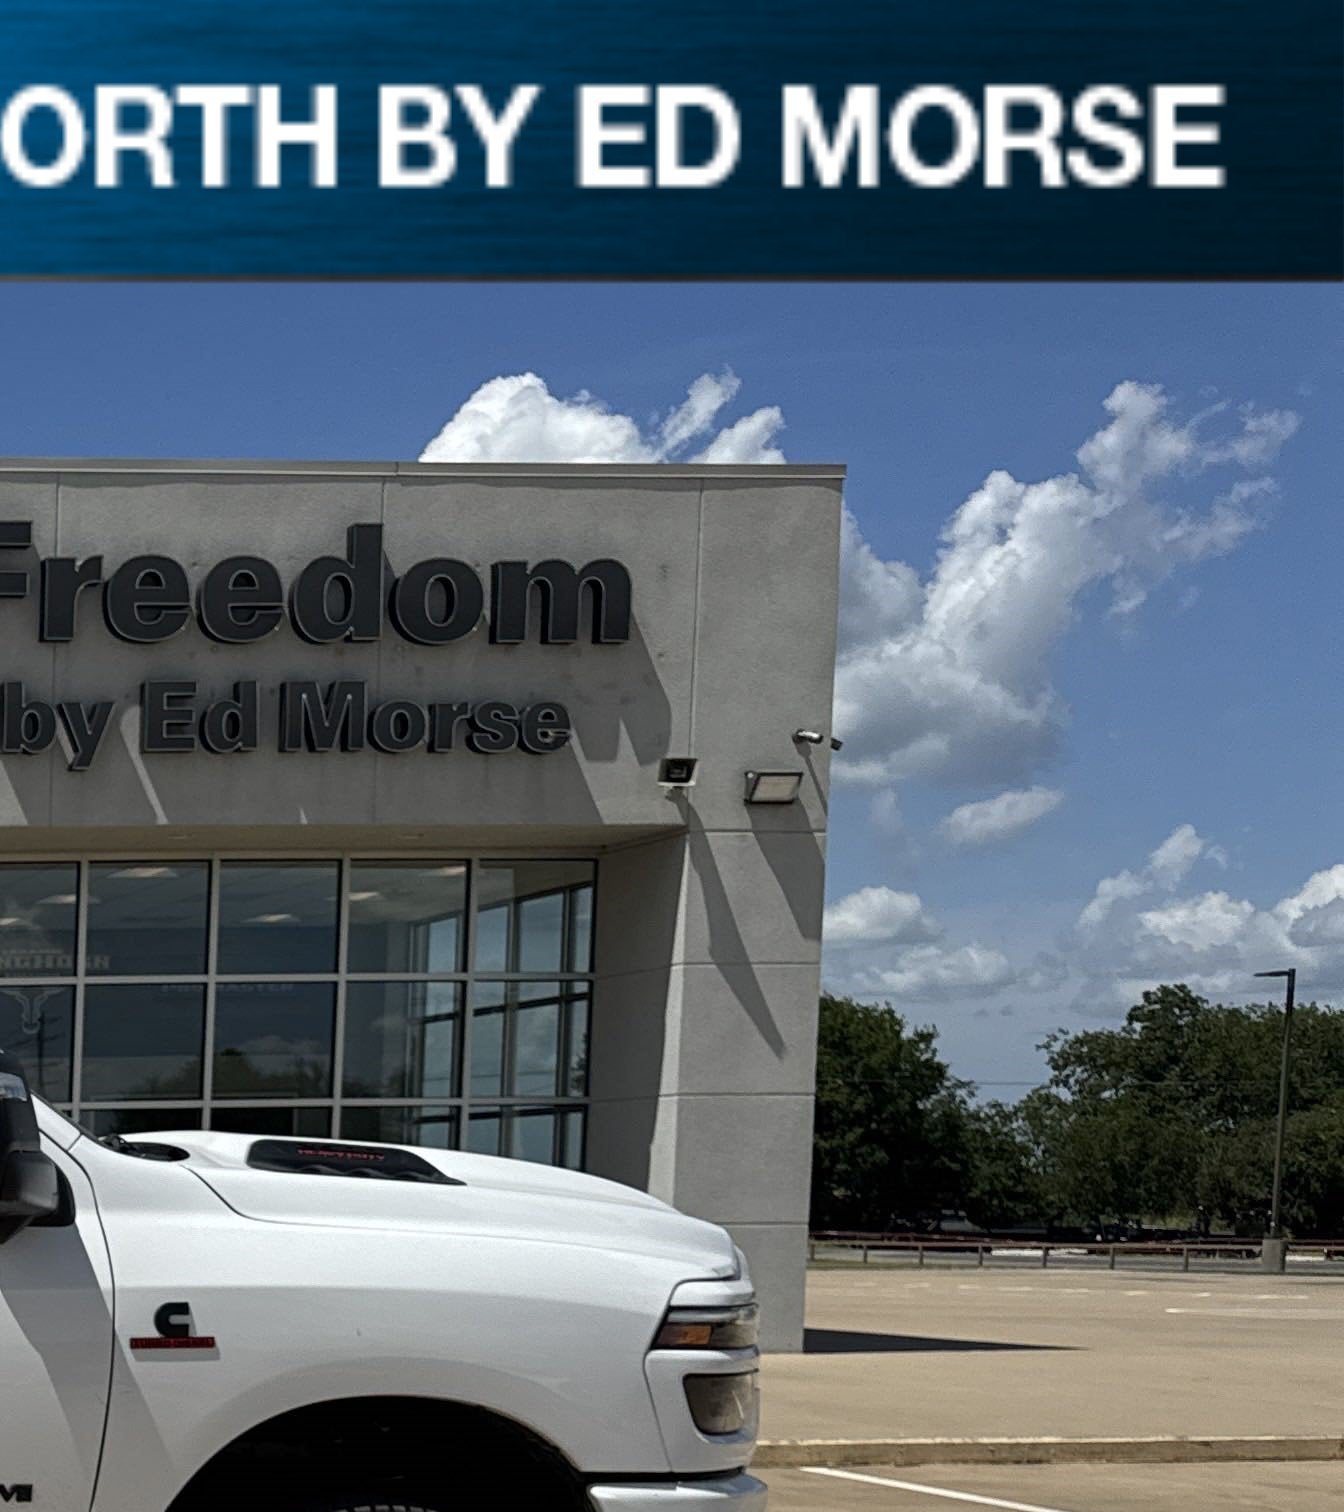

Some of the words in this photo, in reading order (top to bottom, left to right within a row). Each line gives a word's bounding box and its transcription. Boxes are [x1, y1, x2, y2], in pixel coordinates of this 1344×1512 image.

[0, 680, 115, 771] by
[140, 680, 258, 755] Ed
[279, 680, 572, 756] Morse
